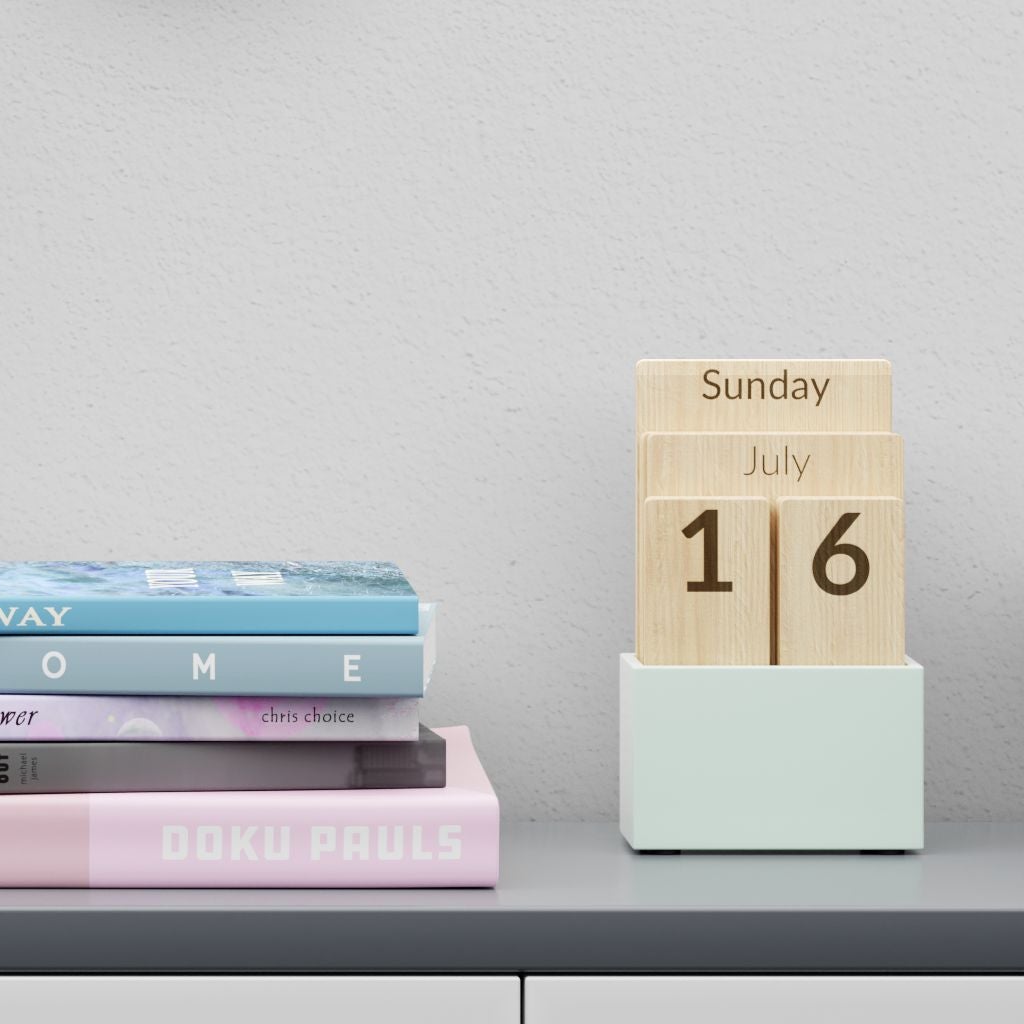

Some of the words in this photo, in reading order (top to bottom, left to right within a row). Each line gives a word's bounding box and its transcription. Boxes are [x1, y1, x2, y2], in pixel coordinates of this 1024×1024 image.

[702, 369, 830, 406] Sunday
[744, 445, 811, 482] July
[261, 706, 299, 724] chris
[304, 706, 355, 724] choice
[162, 825, 291, 861] DOKU
[310, 824, 462, 861] PAULS
